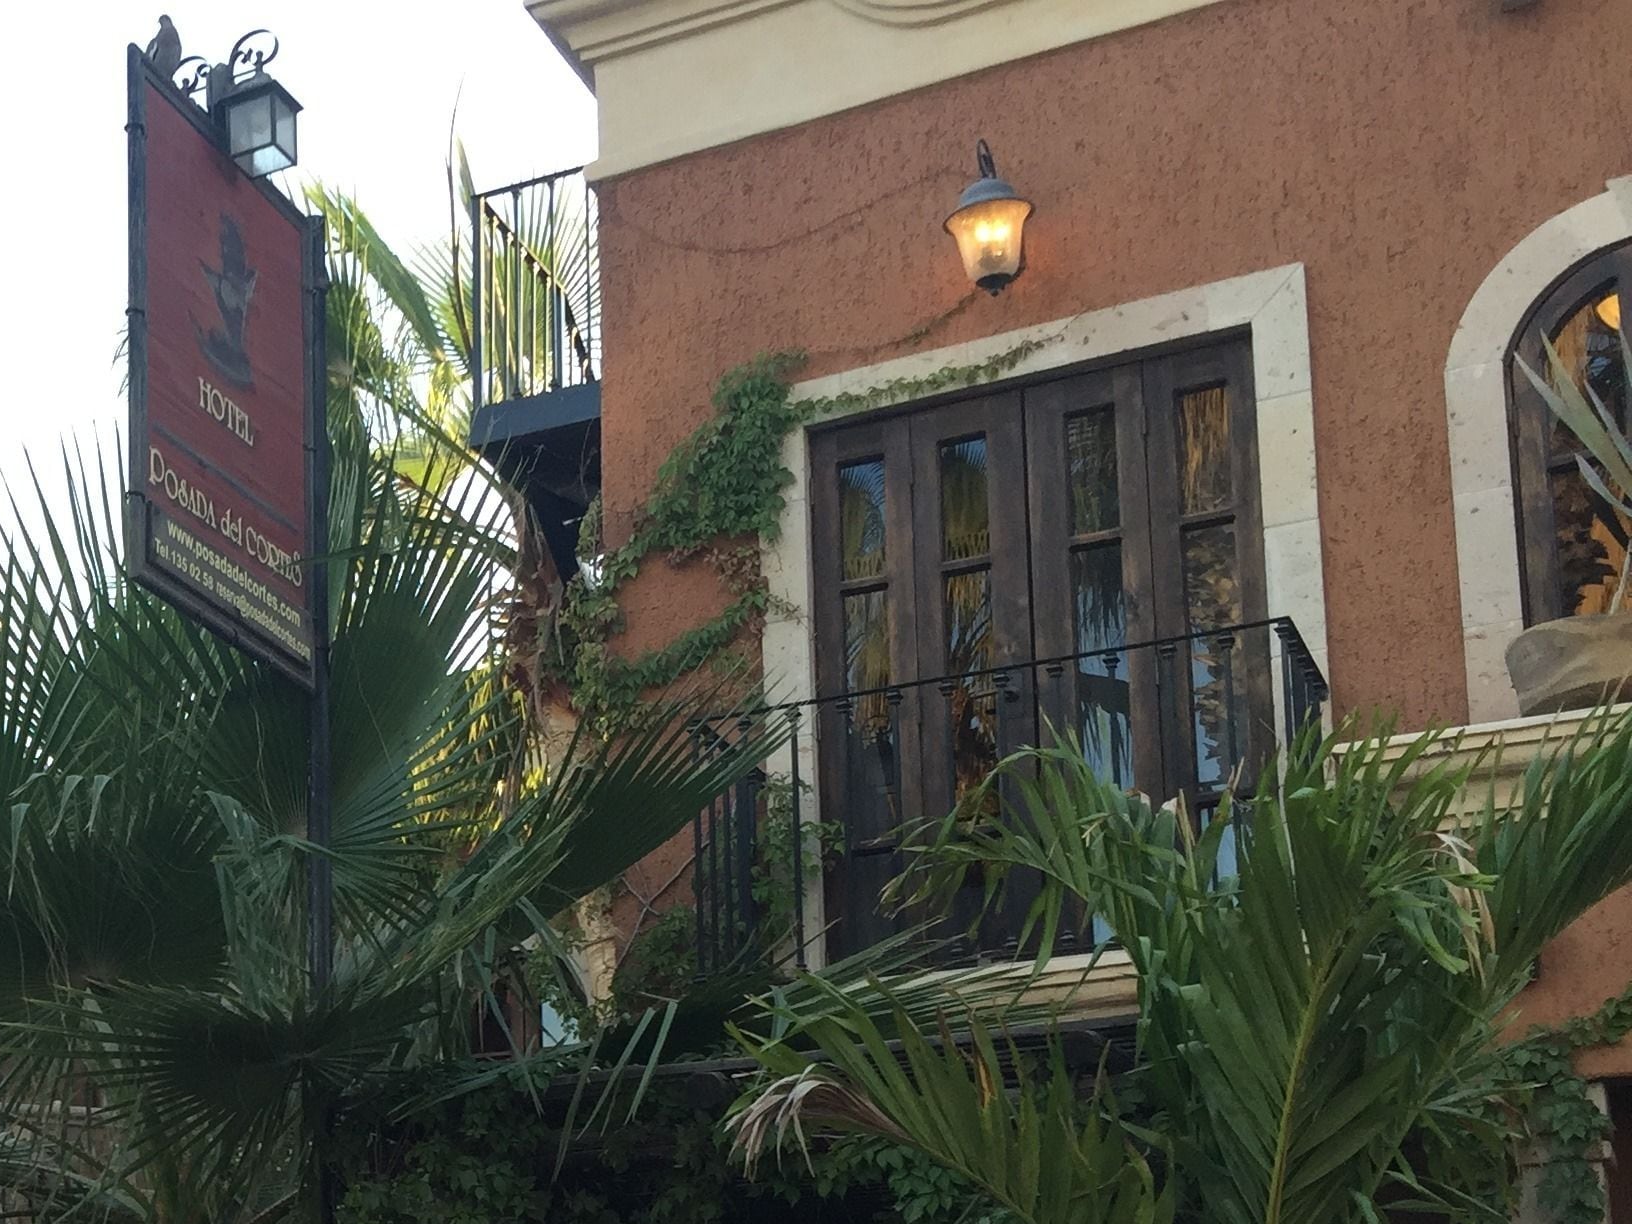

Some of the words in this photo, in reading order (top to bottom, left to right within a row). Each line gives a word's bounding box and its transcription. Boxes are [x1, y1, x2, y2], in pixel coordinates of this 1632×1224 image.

[198, 376, 254, 447] HOTEL
[149, 446, 217, 529] POSADA
[220, 507, 243, 546] del
[167, 519, 301, 628] www.posadadelcortes.com
[189, 562, 201, 582] 02
